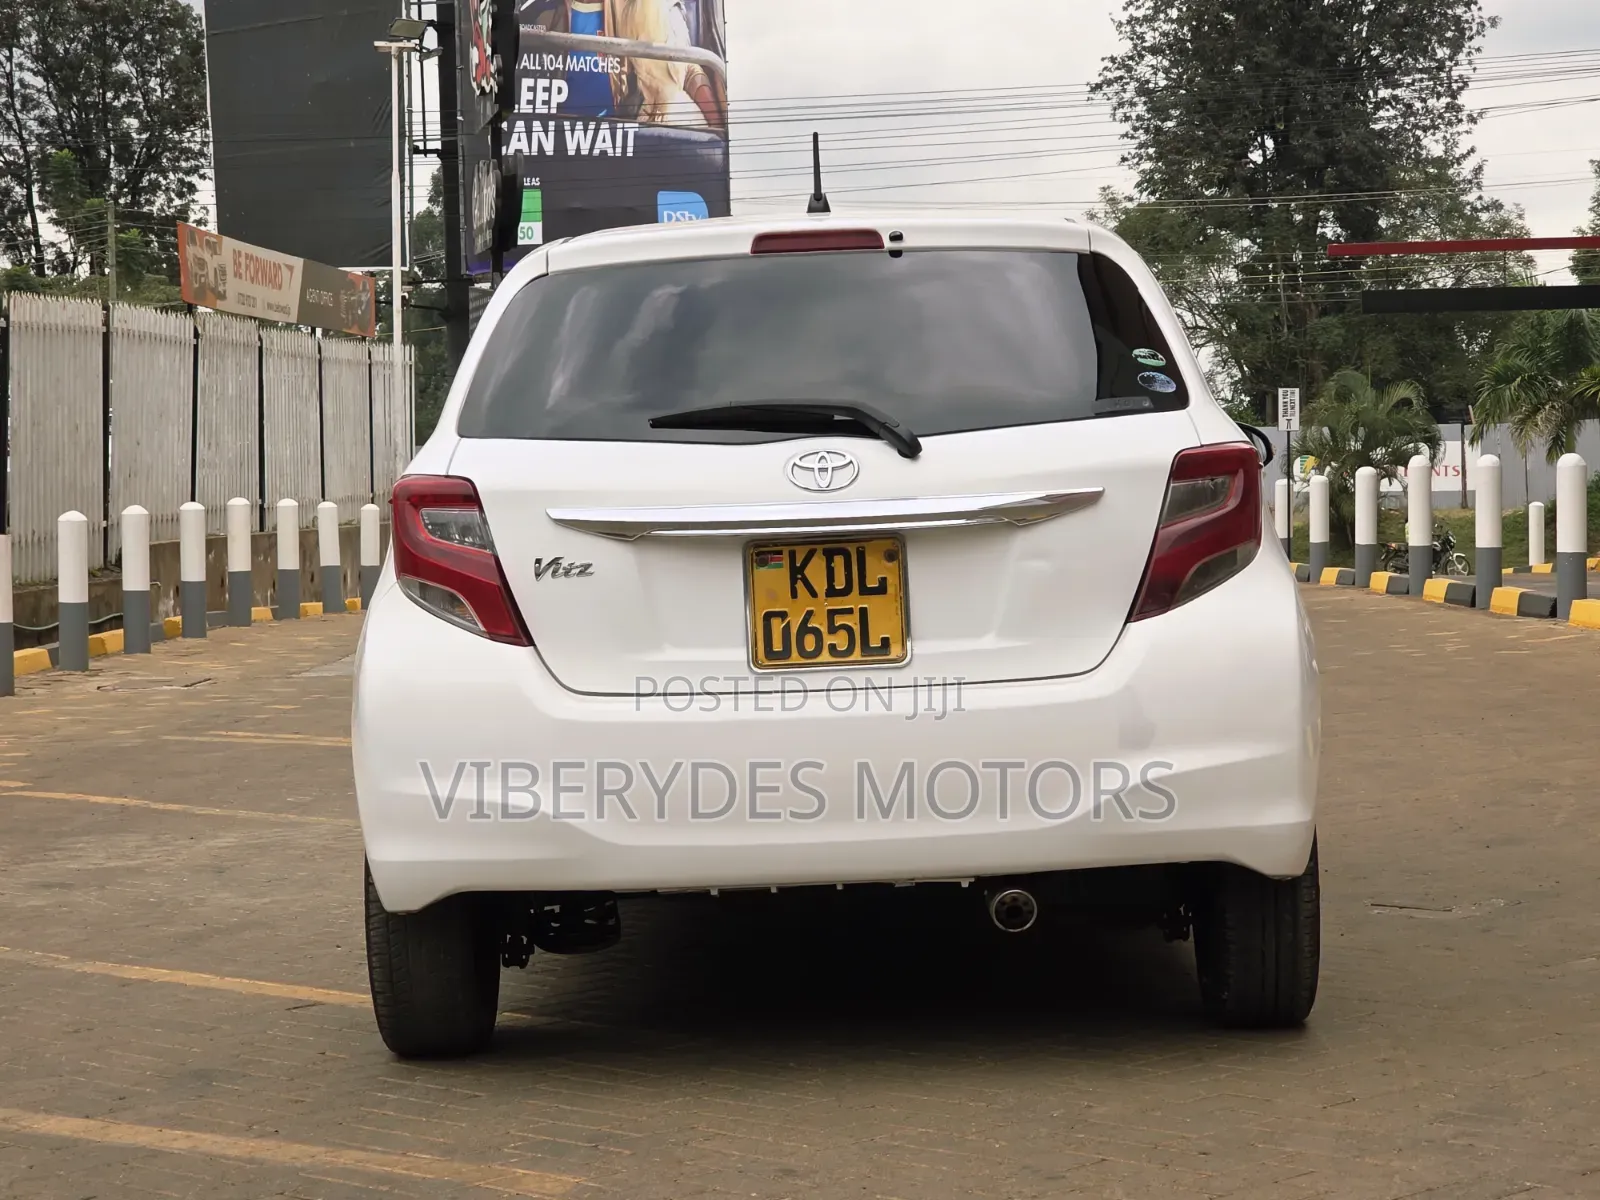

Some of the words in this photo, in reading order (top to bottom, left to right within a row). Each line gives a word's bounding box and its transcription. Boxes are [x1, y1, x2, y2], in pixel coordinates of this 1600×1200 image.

[520, 53, 541, 70] ALL
[543, 54, 563, 71] 104
[565, 55, 620, 73] MATCHES
[513, 78, 568, 113] EEP
[563, 121, 639, 156] WAIT
[232, 248, 242, 280] BE
[245, 252, 283, 291] FORWARD
[534, 556, 595, 582] Vitz
[788, 546, 888, 599] KDL
[762, 605, 891, 661] 065L
